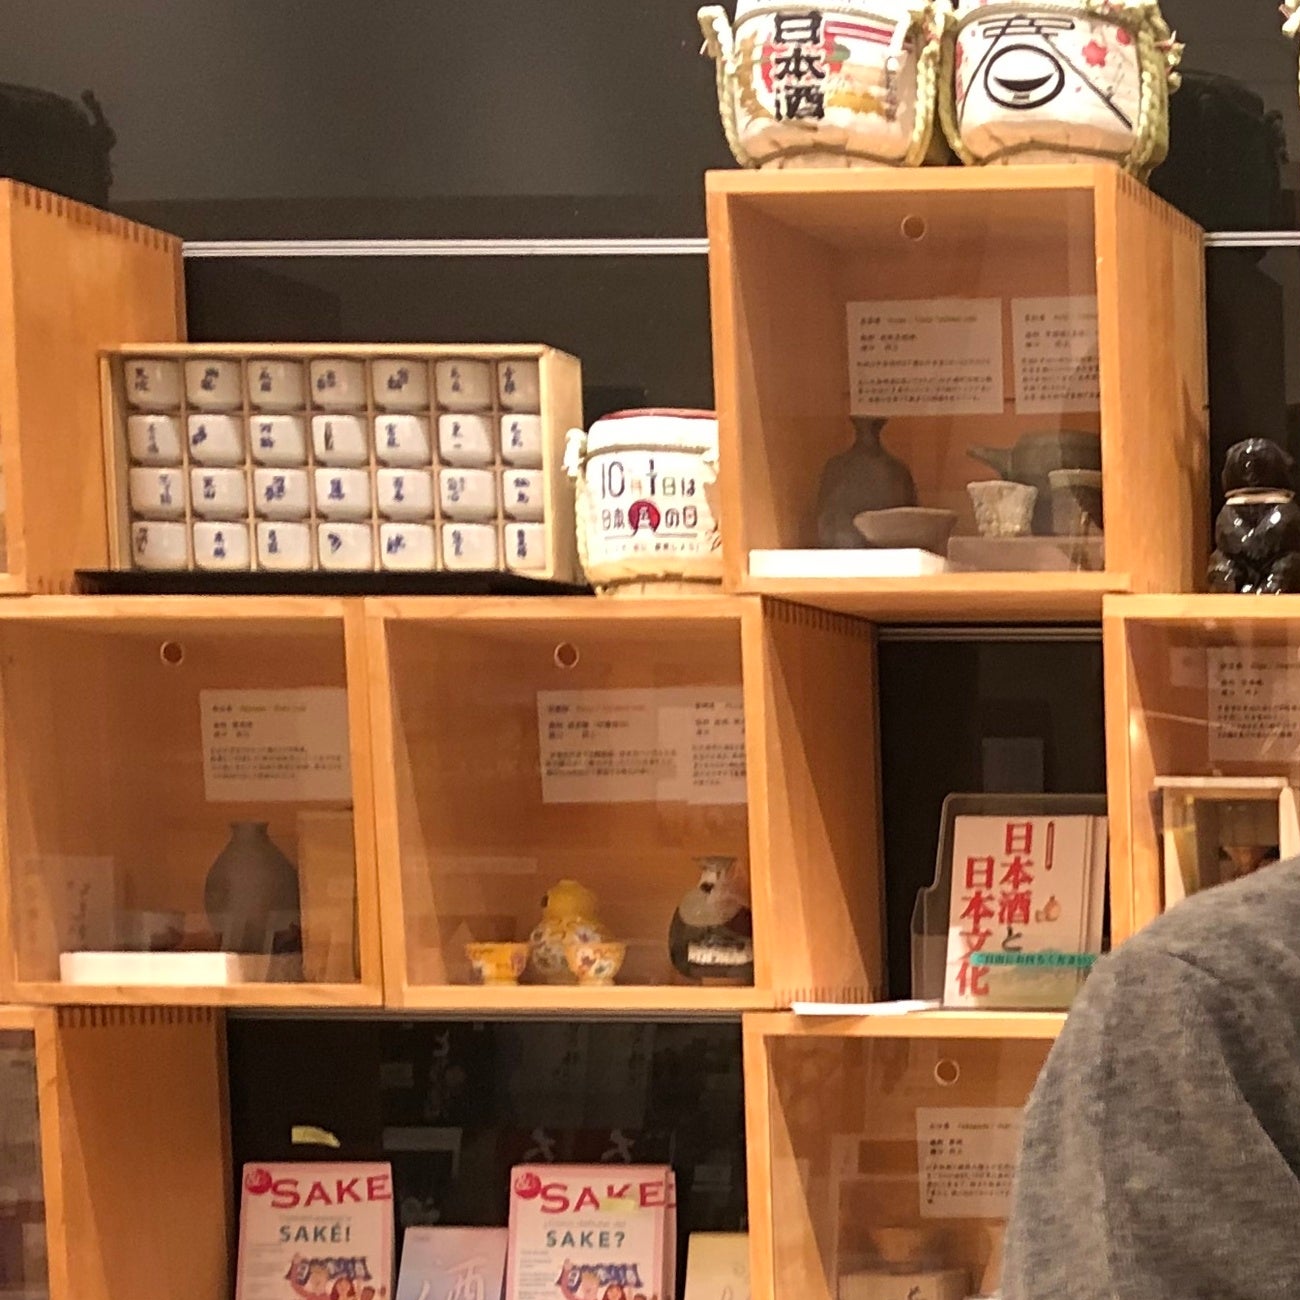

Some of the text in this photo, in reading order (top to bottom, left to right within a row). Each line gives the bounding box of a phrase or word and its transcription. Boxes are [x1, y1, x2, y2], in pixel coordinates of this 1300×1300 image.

[774, 10, 825, 121] 日本酒
[999, 822, 1034, 951] 日本酒と
[956, 856, 994, 996] 日本文化
[271, 1174, 391, 1208] SAKE
[540, 1181, 664, 1213] SAKE
[546, 1230, 626, 1249] SAKE?
